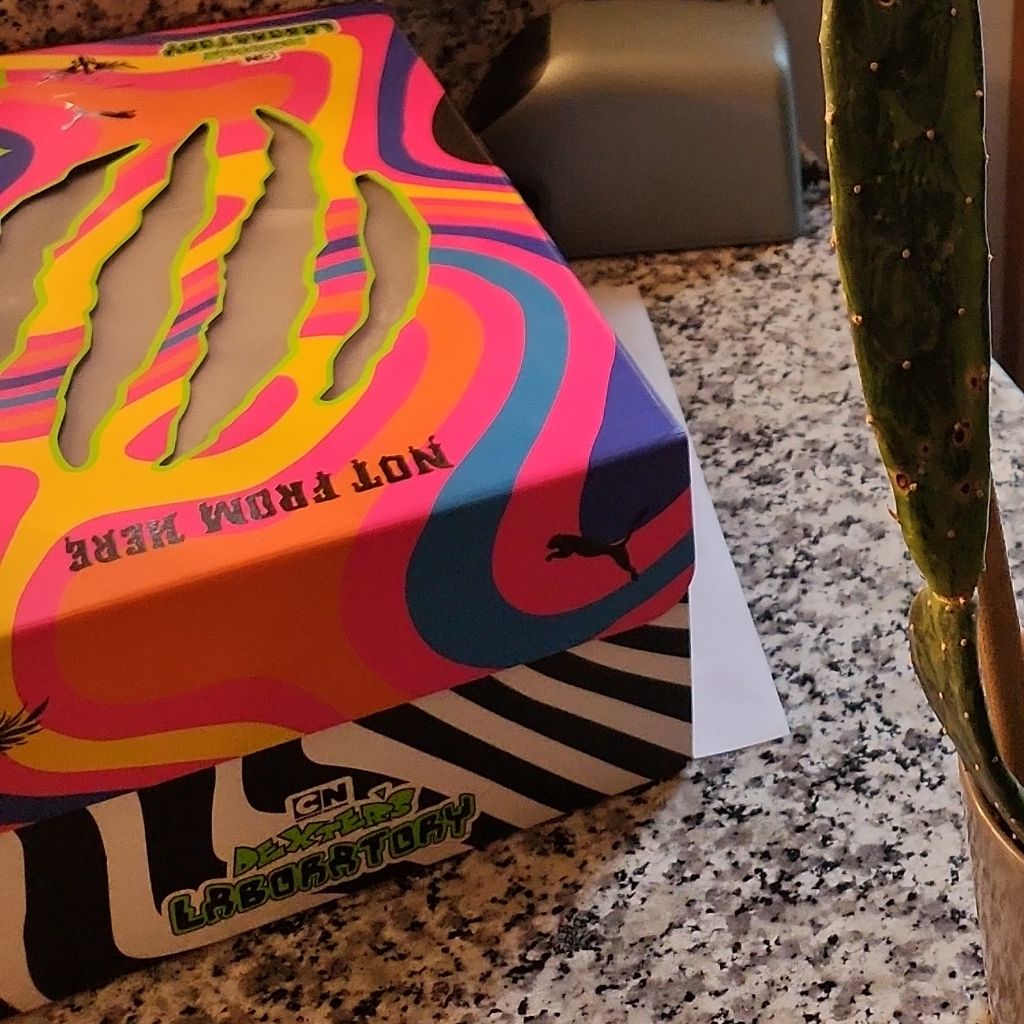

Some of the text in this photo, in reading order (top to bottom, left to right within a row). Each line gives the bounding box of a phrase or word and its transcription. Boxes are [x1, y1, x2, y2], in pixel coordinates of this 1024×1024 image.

[65, 436, 454, 571] NOT FROM HERE
[168, 793, 475, 936] LABORATORY
[292, 782, 350, 814] CN
